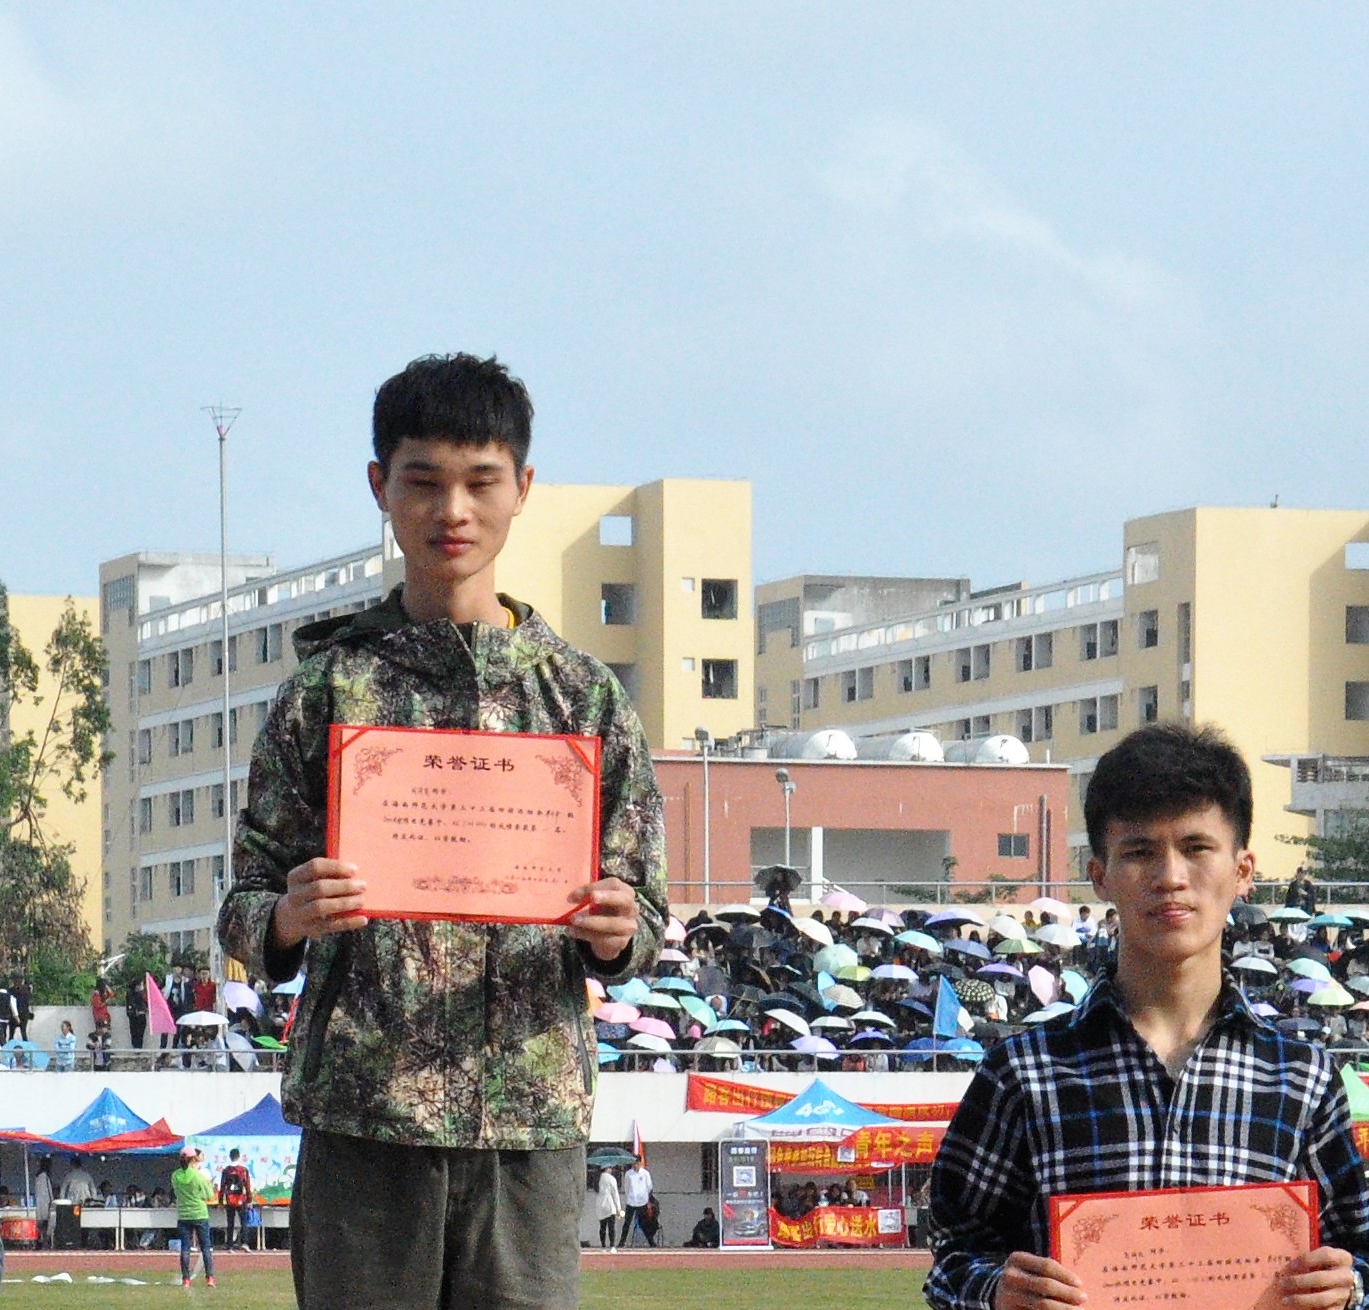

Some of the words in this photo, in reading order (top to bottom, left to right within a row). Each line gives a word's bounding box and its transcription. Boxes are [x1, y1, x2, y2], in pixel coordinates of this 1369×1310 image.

[423, 754, 515, 772] 荣誉证书
[856, 1129, 934, 1159] 青年之声
[1139, 1212, 1231, 1230] 荣誉证书
